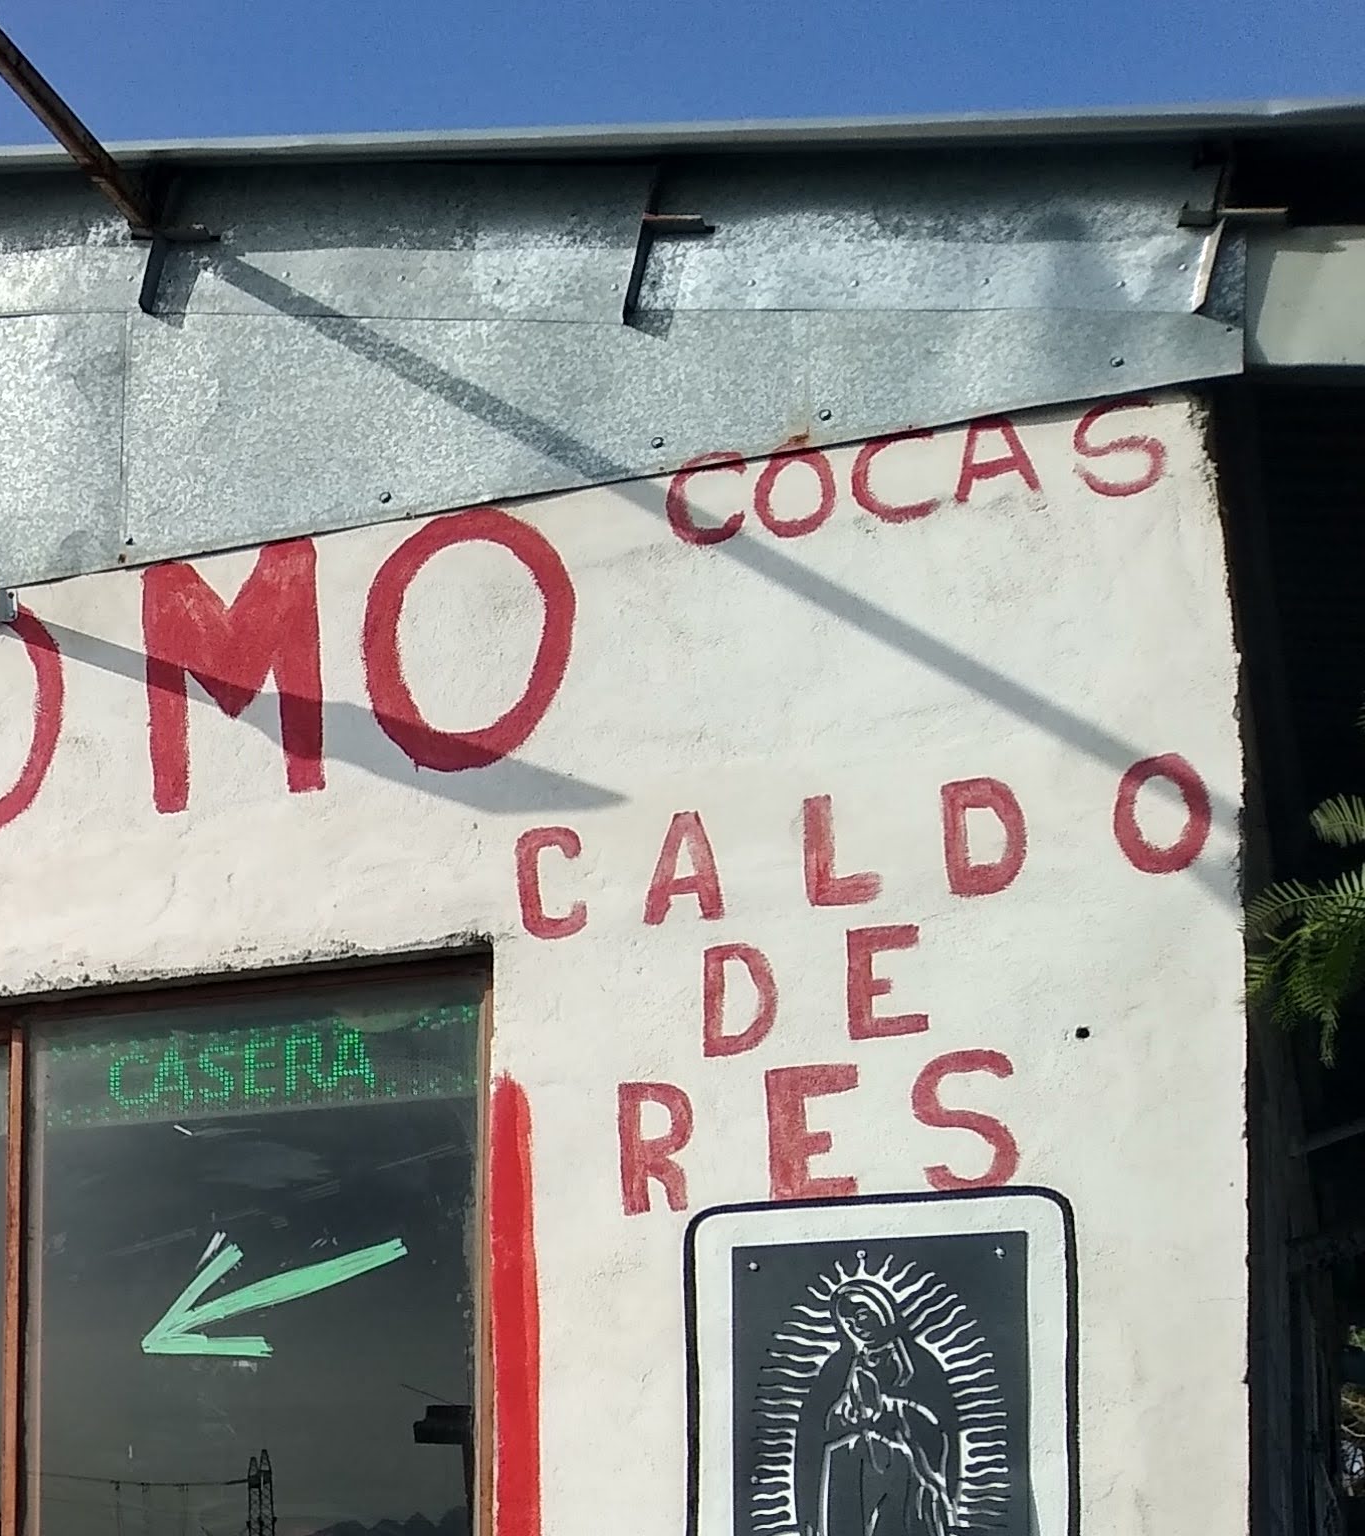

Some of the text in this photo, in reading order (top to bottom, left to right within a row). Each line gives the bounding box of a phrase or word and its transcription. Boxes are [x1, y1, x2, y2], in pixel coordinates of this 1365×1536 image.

[667, 400, 1165, 546] COCAS
[515, 754, 1211, 940] CALDO
[702, 925, 929, 1057] DE
[107, 1028, 376, 1110] CASERA
[617, 1050, 1020, 1215] RES
